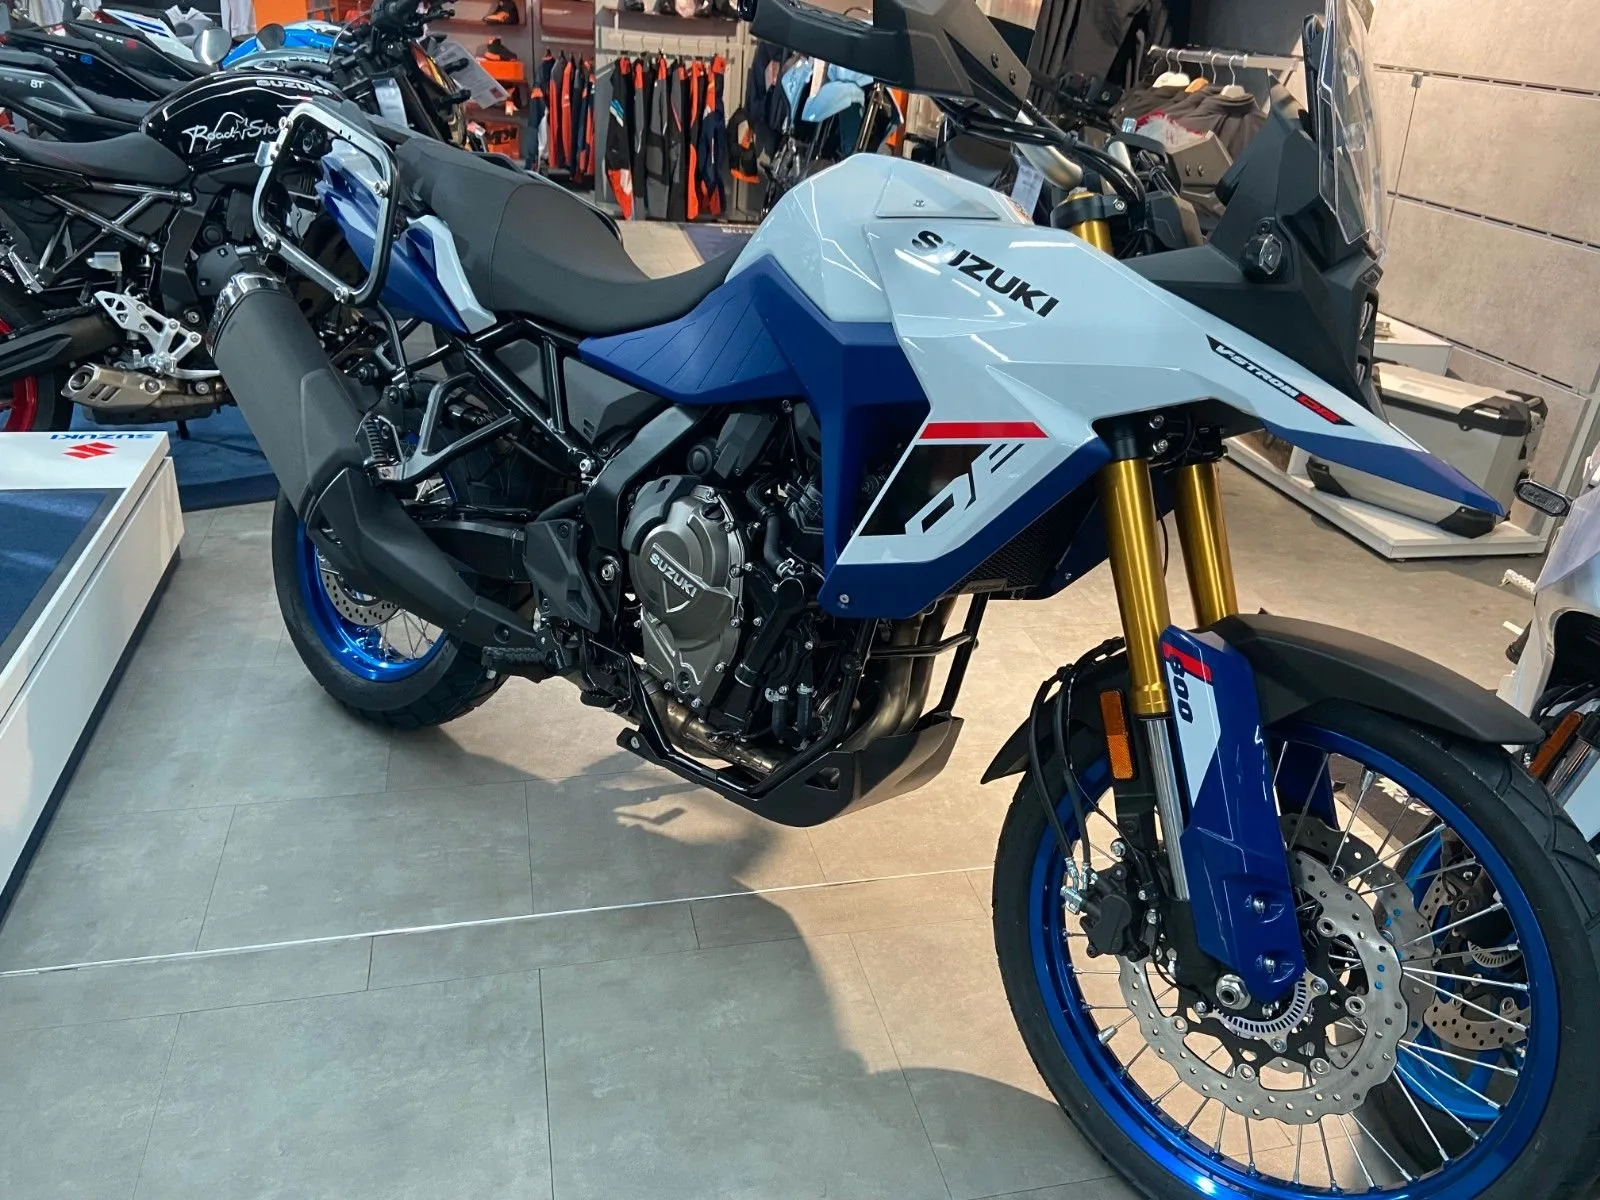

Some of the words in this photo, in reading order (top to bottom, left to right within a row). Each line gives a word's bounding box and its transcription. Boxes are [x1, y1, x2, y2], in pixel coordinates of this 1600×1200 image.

[247, 119, 285, 138] Sta
[649, 552, 698, 598] SUZUKI
[1168, 654, 1194, 724] 800
